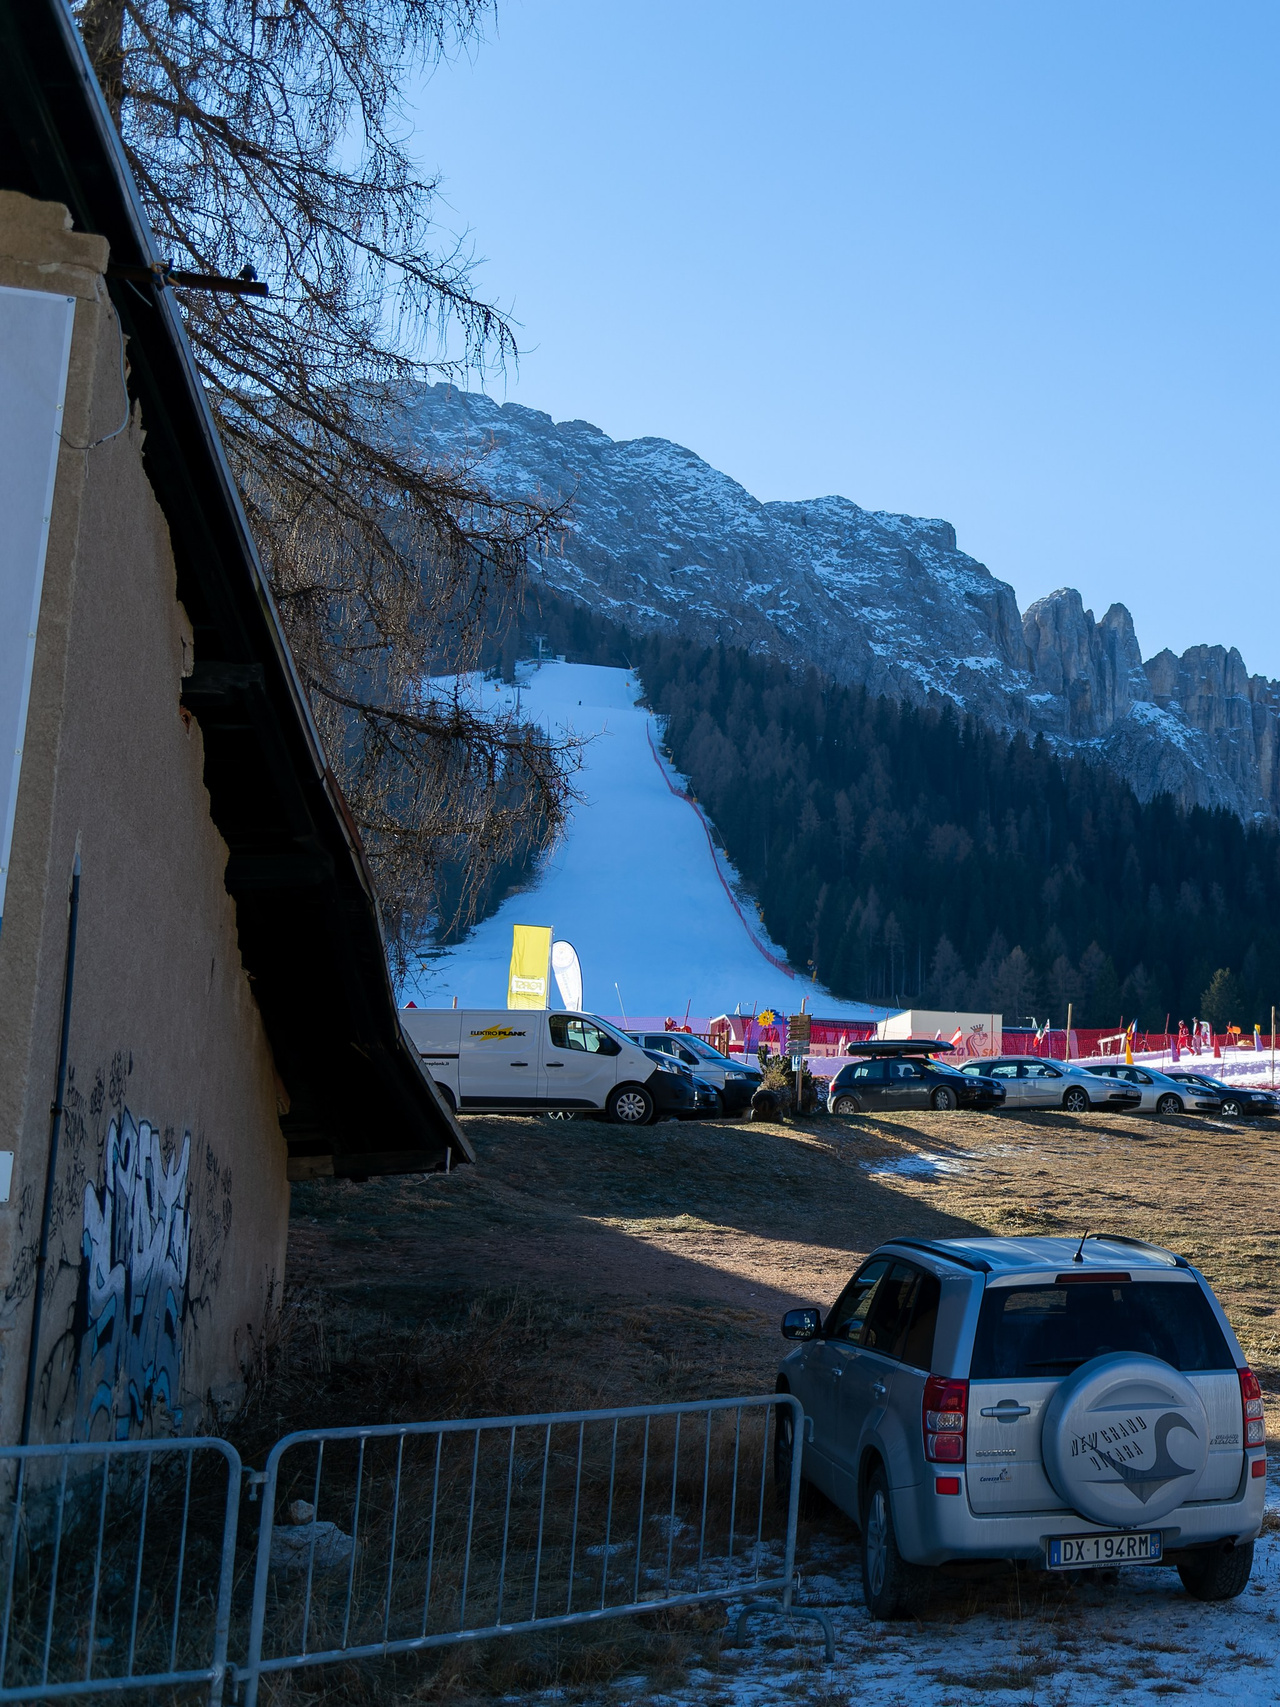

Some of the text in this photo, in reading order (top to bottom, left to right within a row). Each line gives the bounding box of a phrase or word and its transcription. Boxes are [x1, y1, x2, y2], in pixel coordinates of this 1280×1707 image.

[1071, 1416, 1147, 1457] NEW GRAND
[975, 1449, 1016, 1457] SUZUKI
[1063, 1536, 1149, 1561] DX 194RM
